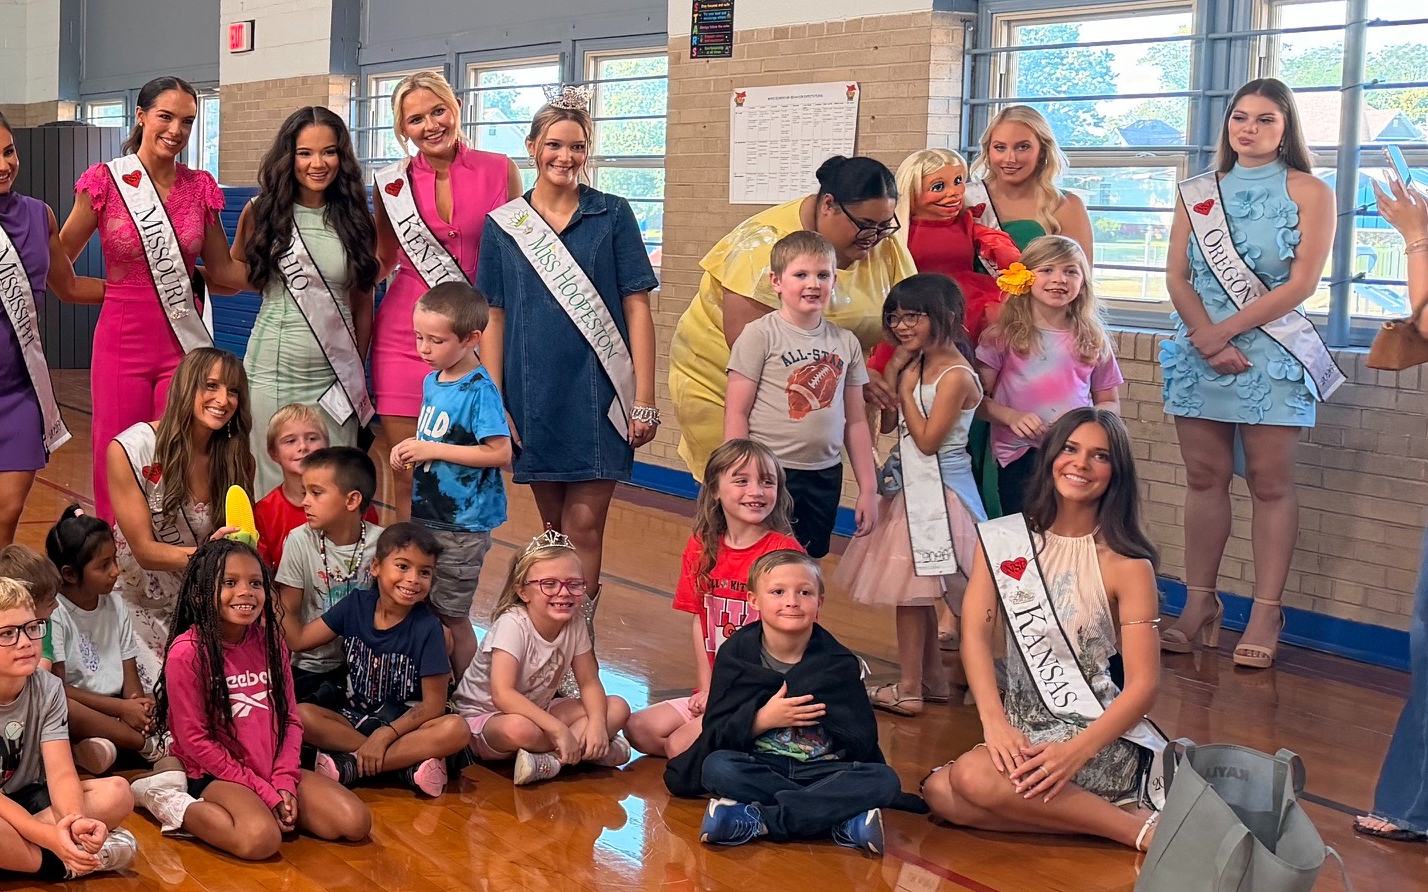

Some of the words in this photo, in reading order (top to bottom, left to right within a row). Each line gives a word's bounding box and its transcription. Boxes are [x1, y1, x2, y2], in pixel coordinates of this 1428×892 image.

[229, 24, 245, 49] EXIT
[134, 204, 187, 307] MISSOURI
[1203, 228, 1259, 305] OREGON
[552, 266, 618, 360] HOOPESTON
[781, 347, 845, 371] ALL-STAR
[225, 669, 272, 689] eebo
[1012, 601, 1078, 708] KANSAS
